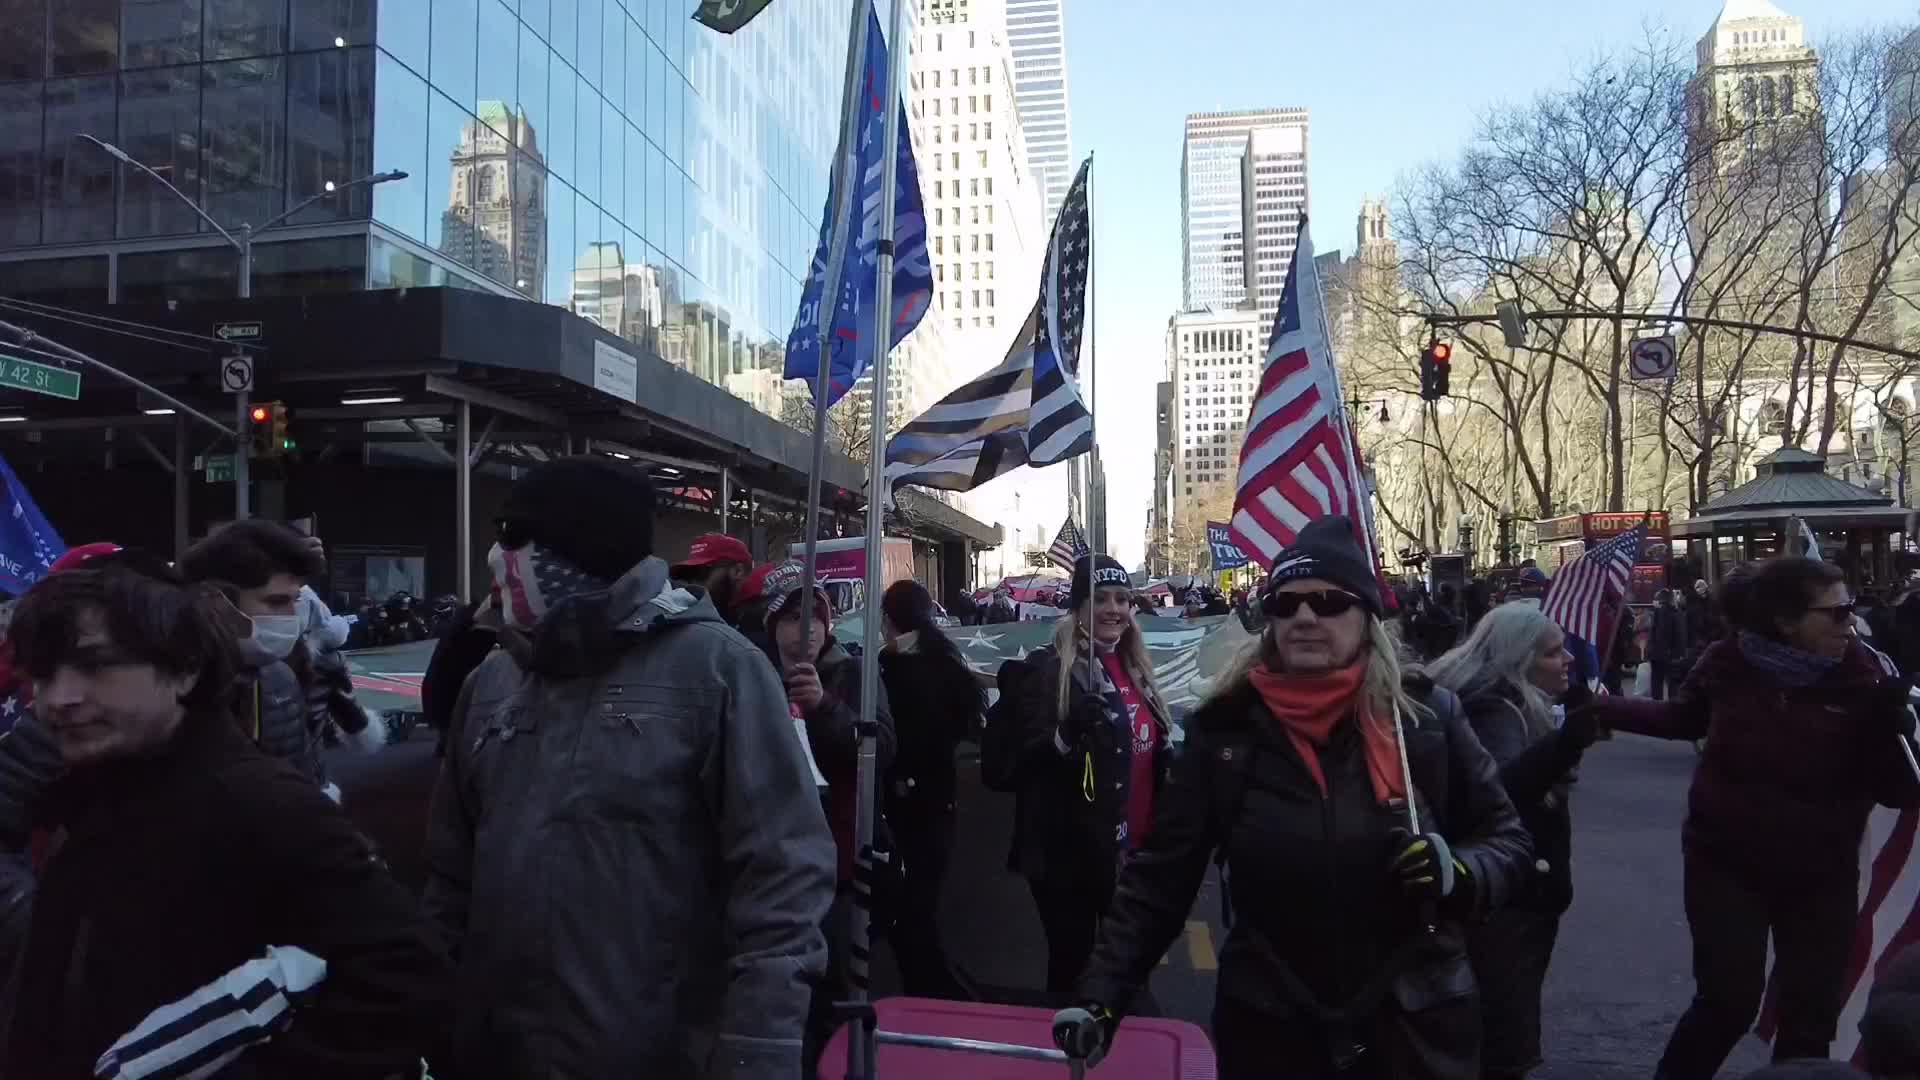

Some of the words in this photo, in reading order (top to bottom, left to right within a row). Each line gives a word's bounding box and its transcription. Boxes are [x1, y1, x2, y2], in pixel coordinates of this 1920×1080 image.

[11, 365, 30, 384] 42
[35, 370, 49, 388] St
[1590, 516, 1620, 531] HOT
[1093, 567, 1127, 584] NYPD
